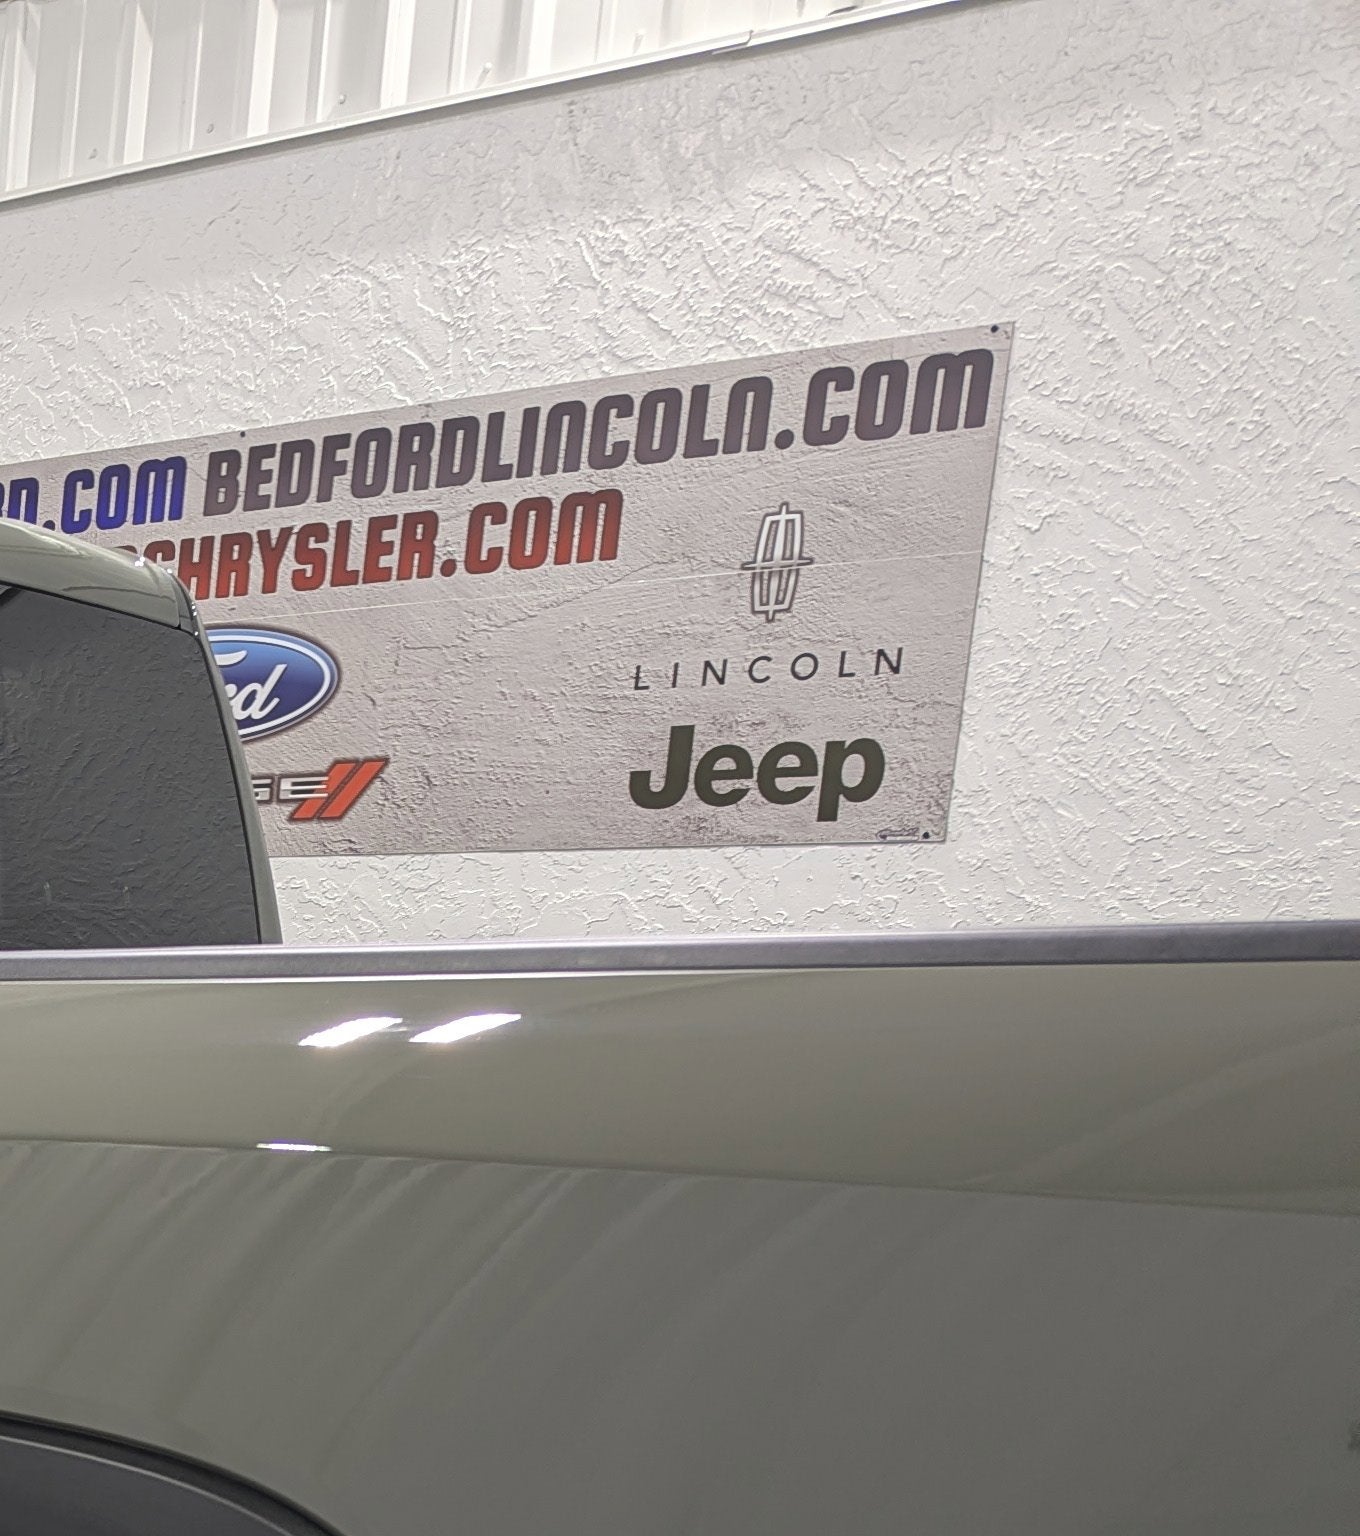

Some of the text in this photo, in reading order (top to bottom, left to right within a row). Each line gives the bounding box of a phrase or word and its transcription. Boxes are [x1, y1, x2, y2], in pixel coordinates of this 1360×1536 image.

[203, 348, 994, 516] BEDFORDLINCOLN.COM
[115, 488, 624, 600] HRYSLER.COM
[633, 647, 904, 691] LINCOLN
[630, 724, 886, 822] Jeep
